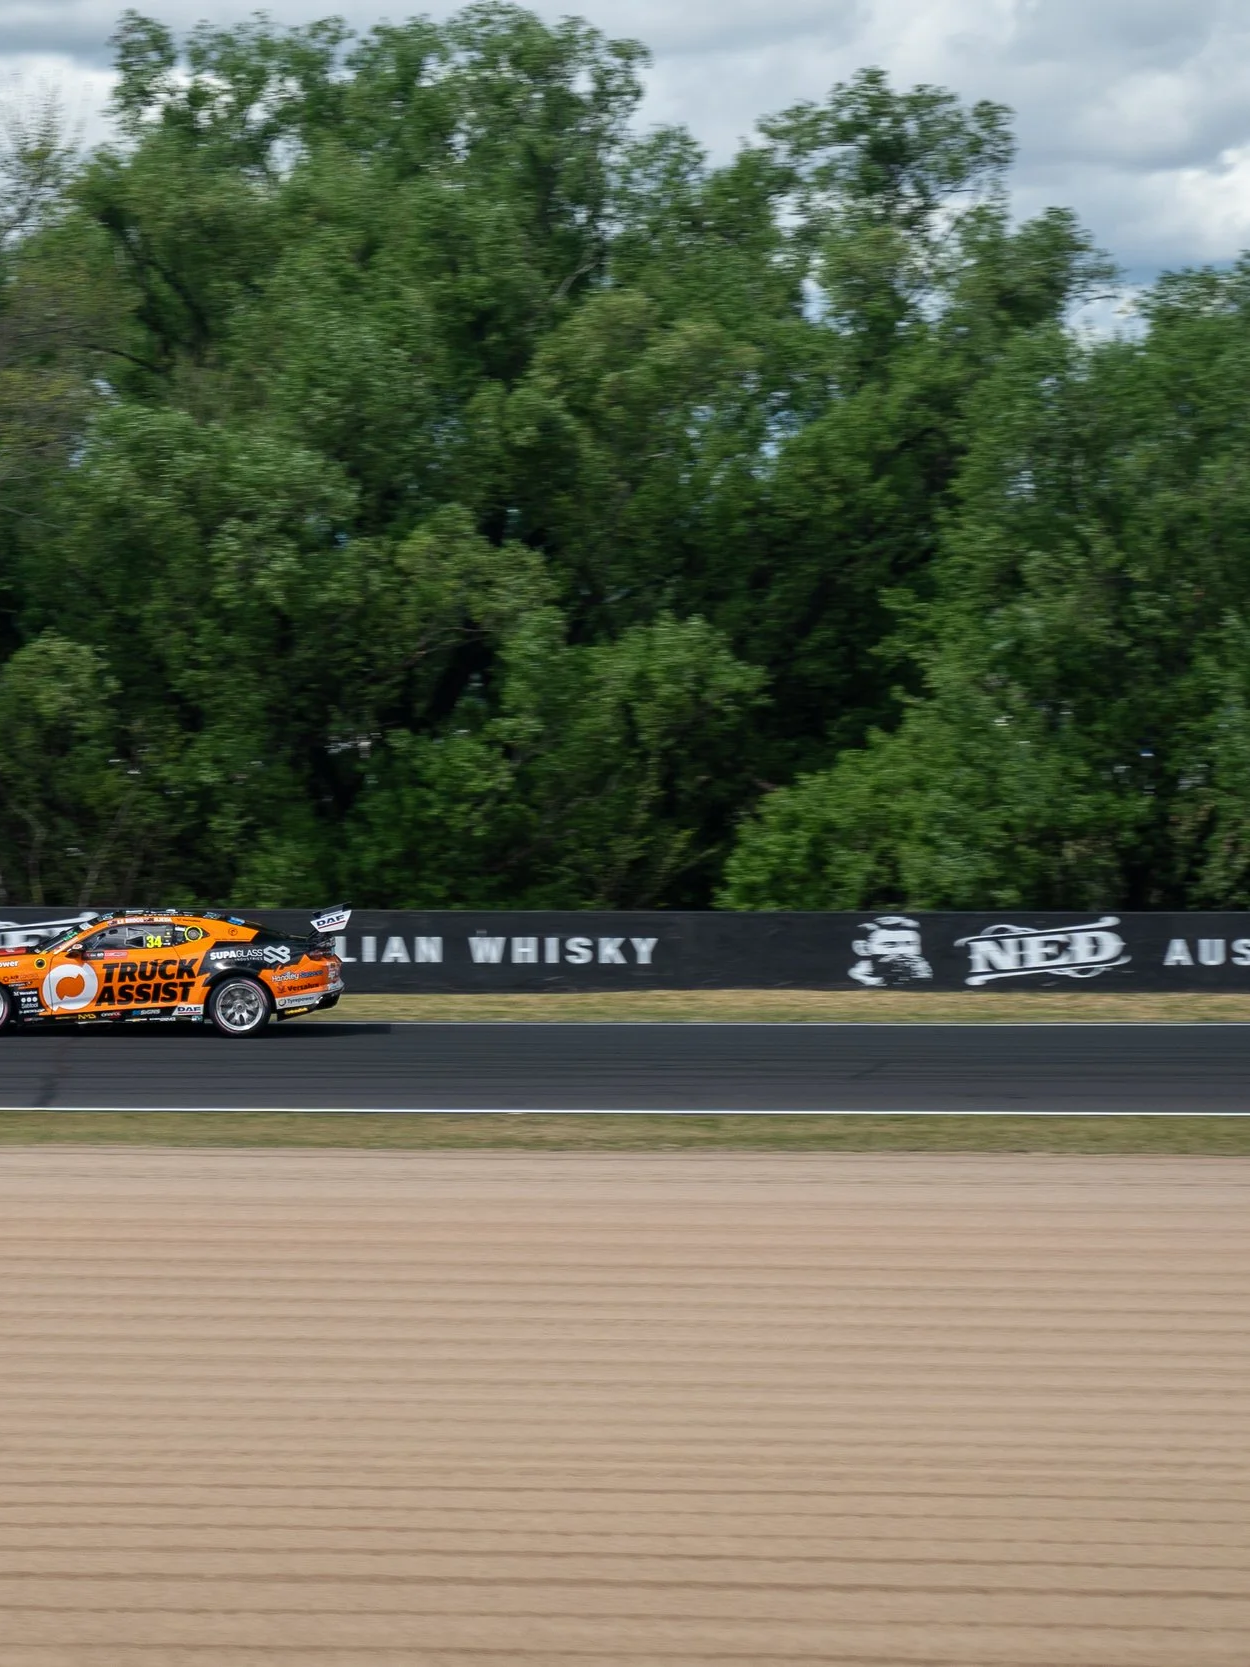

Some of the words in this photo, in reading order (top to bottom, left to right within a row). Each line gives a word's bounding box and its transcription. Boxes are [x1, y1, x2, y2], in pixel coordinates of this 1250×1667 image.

[316, 914, 345, 927] DAF
[146, 935, 162, 948] 34
[468, 936, 658, 964] WHISKY
[102, 958, 198, 983] TRUCK
[95, 981, 195, 1006] ASSIST
[288, 983, 319, 991] Versalux
